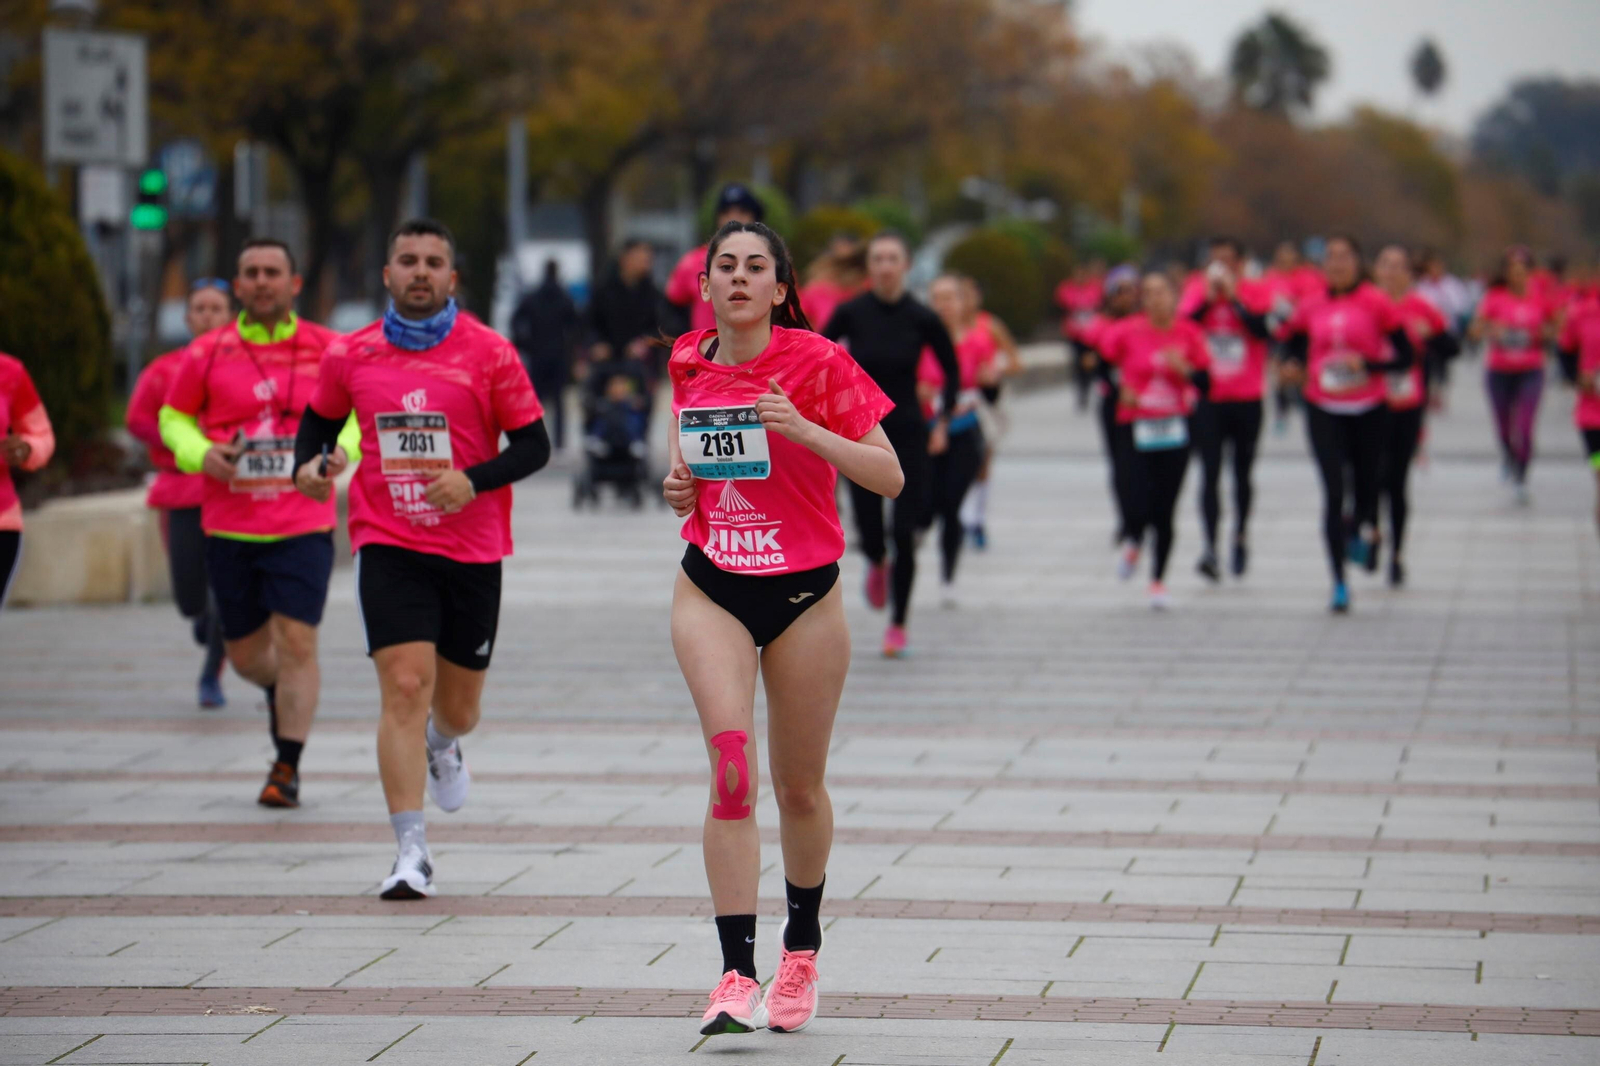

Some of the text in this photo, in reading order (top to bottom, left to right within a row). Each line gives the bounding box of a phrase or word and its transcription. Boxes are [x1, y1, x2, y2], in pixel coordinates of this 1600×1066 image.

[398, 433, 435, 453] 2031
[700, 431, 745, 456] 2131
[388, 482, 426, 501] PIN
[709, 511, 766, 522] VIII DICIÓN
[703, 544, 785, 567] RUNNING
